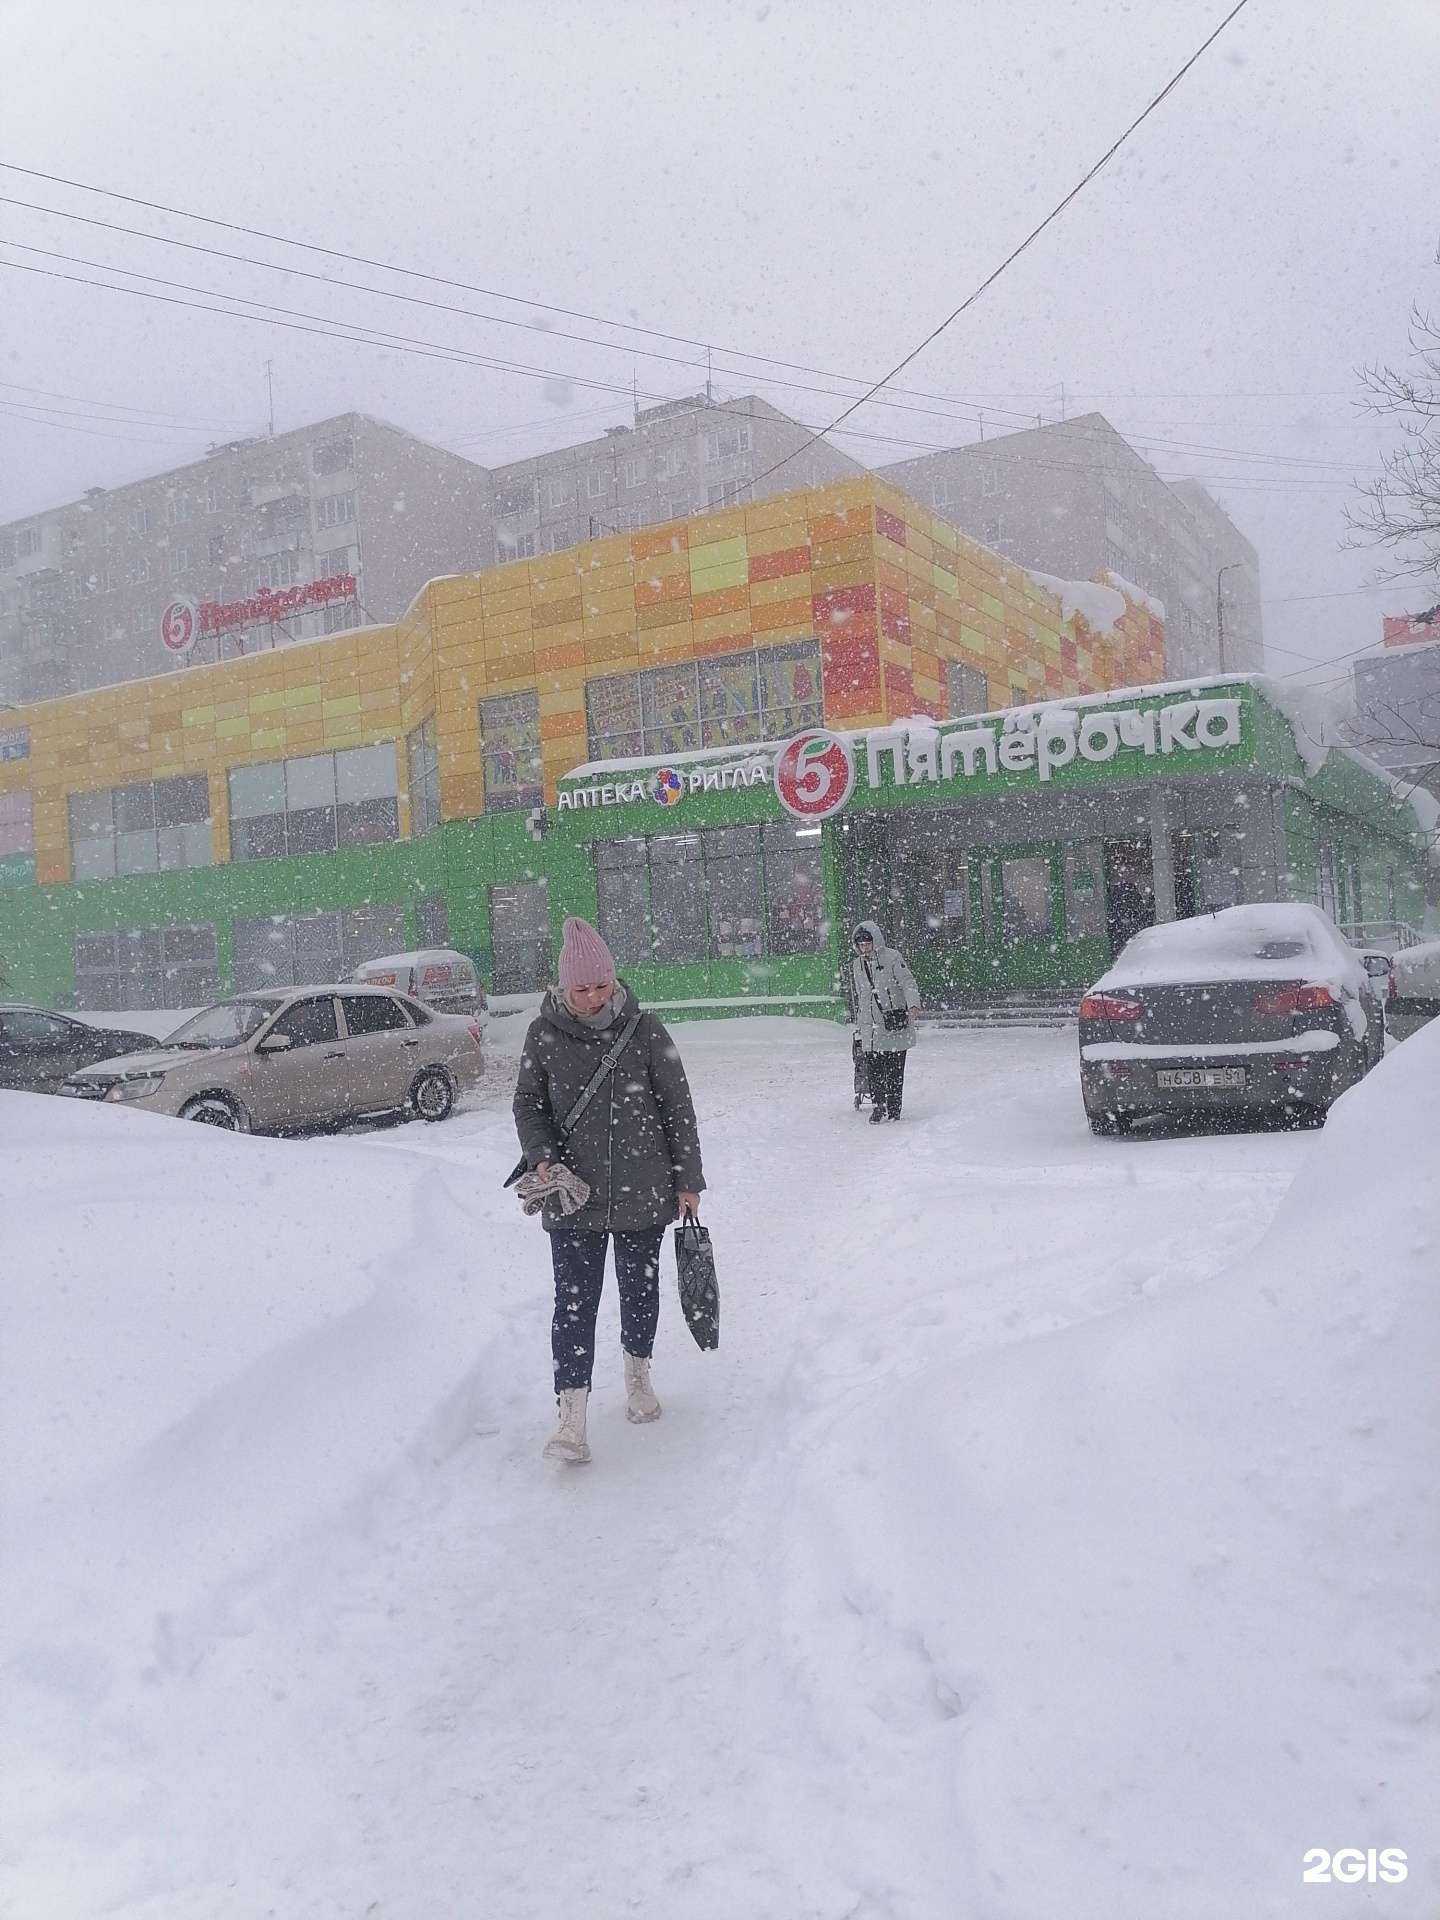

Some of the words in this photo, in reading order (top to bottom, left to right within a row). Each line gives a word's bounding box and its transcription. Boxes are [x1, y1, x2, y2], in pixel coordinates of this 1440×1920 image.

[866, 699, 1241, 787] Пятёрочка
[557, 780, 646, 811] АПТЕКА
[688, 765, 768, 794] РИГЛА
